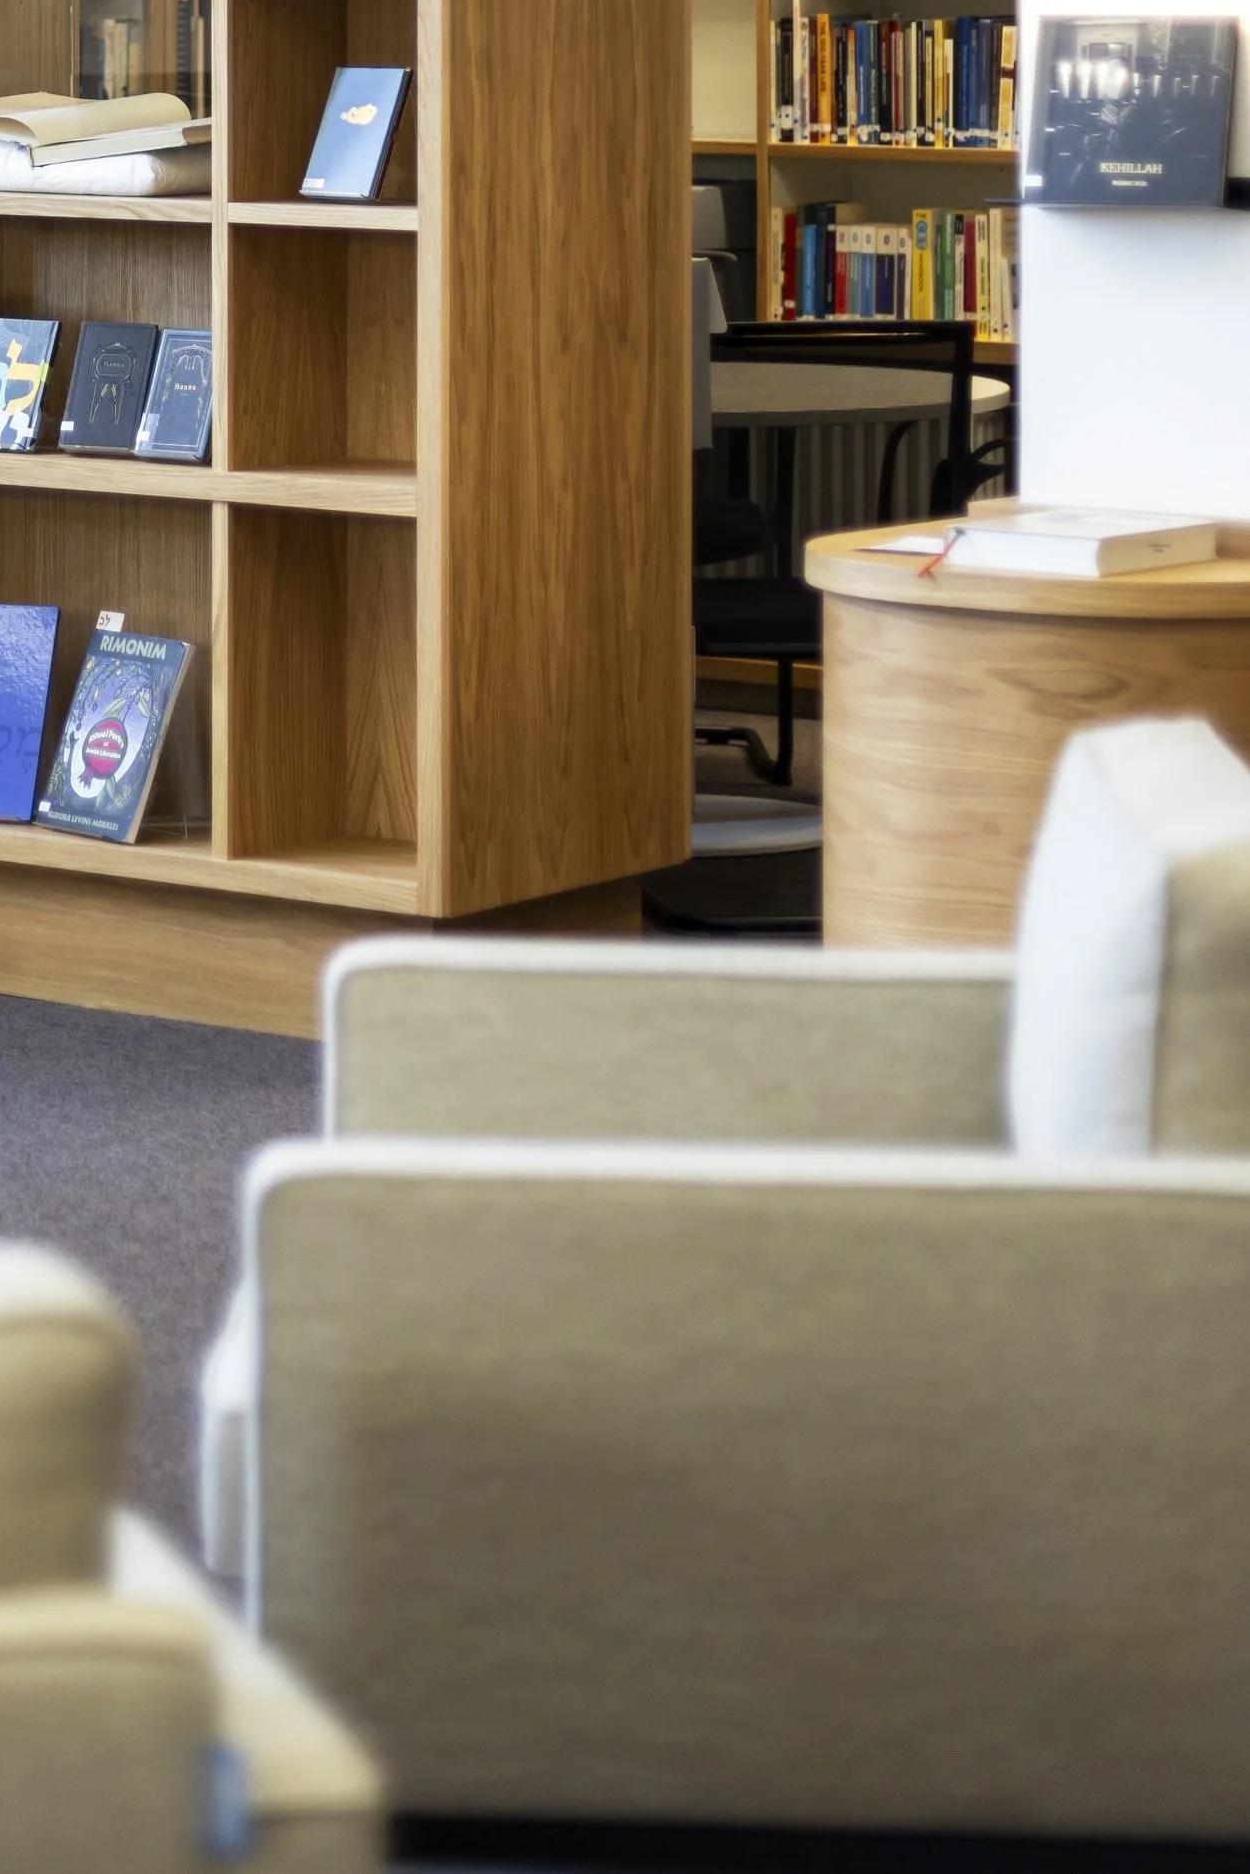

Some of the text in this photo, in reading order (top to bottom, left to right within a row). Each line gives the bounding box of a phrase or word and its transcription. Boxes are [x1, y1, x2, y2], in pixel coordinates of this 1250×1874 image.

[1100, 162, 1163, 174] KEHILLAH
[99, 635, 167, 660] RIMONIM
[88, 730, 125, 749] Ritual Poetry
[85, 747, 100, 755] Jewish
[47, 811, 119, 831] AURORA LEVINS MORALES
